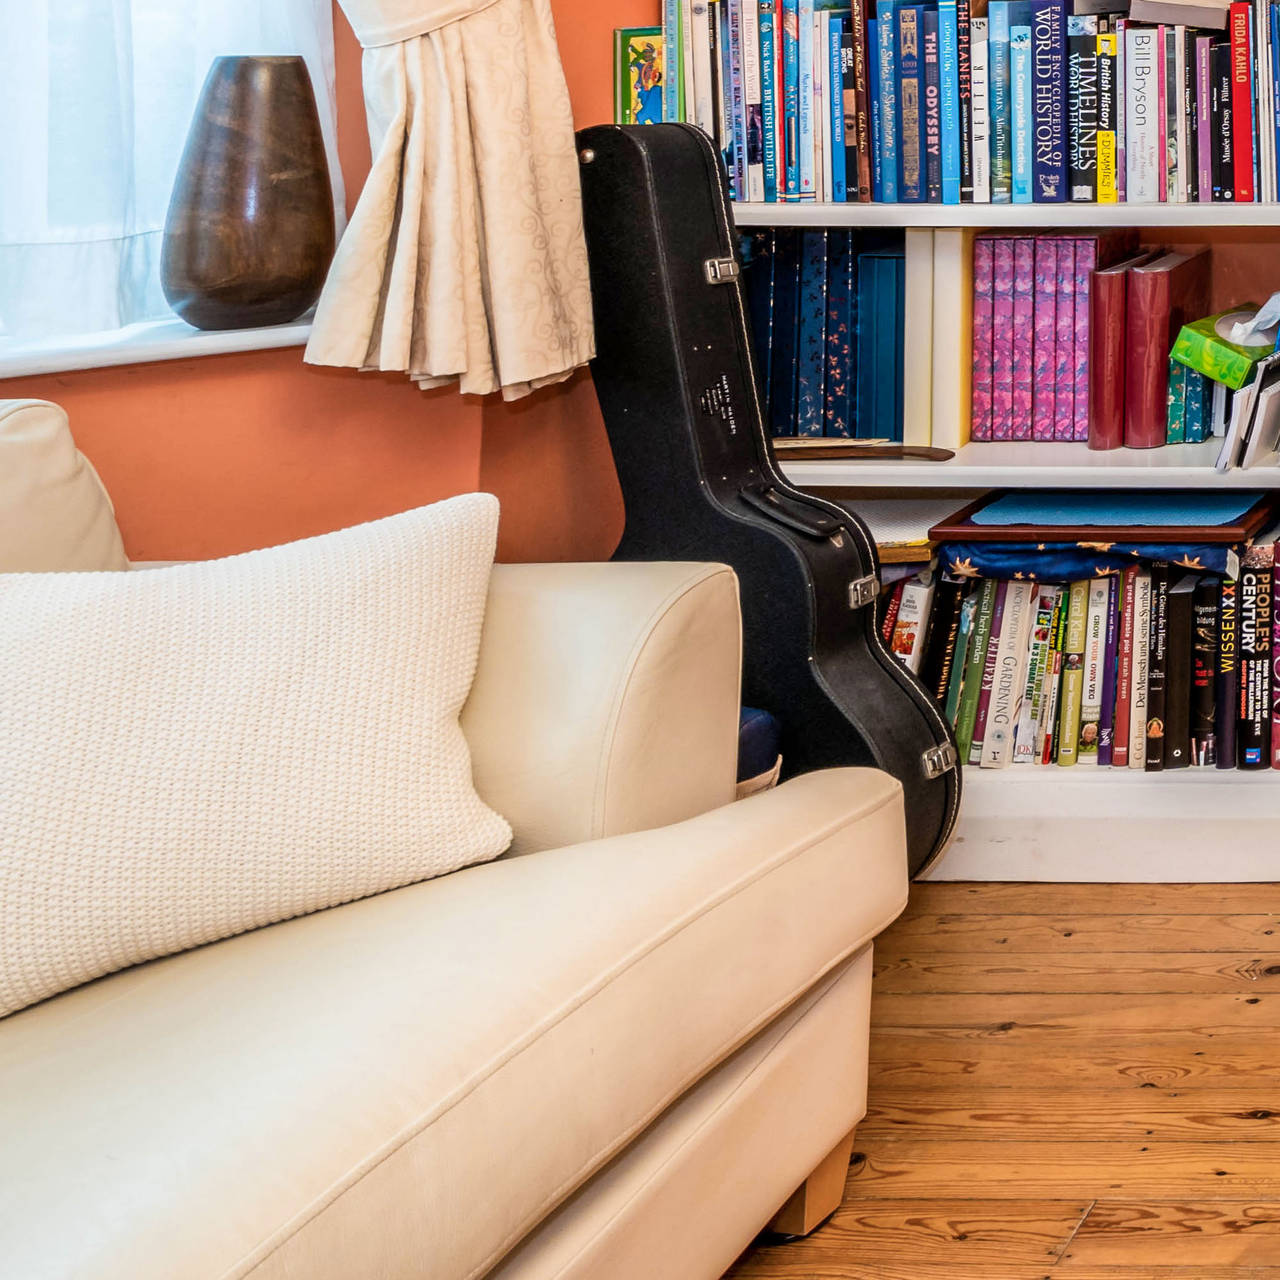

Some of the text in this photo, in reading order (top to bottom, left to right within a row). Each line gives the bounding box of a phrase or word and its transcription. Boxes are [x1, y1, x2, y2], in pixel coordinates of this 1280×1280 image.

[925, 32, 936, 62] THE
[958, 3, 970, 98] THE PLANETS
[1133, 36, 1151, 126] Bill Bryson
[1234, 13, 1248, 82] FRIDA KAHLO
[764, 89, 772, 129] BRITISH
[926, 86, 938, 155] ODYSSEY
[1035, 8, 1052, 166] WORLD HISTORY
[1052, 6, 1062, 168] FAMILY ENCYCLOPEDIA OF
[1078, 52, 1096, 170] TIMELINES
[1100, 58, 1111, 128] British History
[1221, 76, 1231, 163] Musée d'Orsay Führer
[765, 132, 774, 180] WILDLIFE
[1102, 140, 1111, 187] DUMMIES
[1070, 587, 1084, 649] Carol Klein
[1242, 573, 1256, 654] CENTURY
[1256, 573, 1270, 652] PEOPLE'S
[994, 656, 1017, 724] GARDENING
